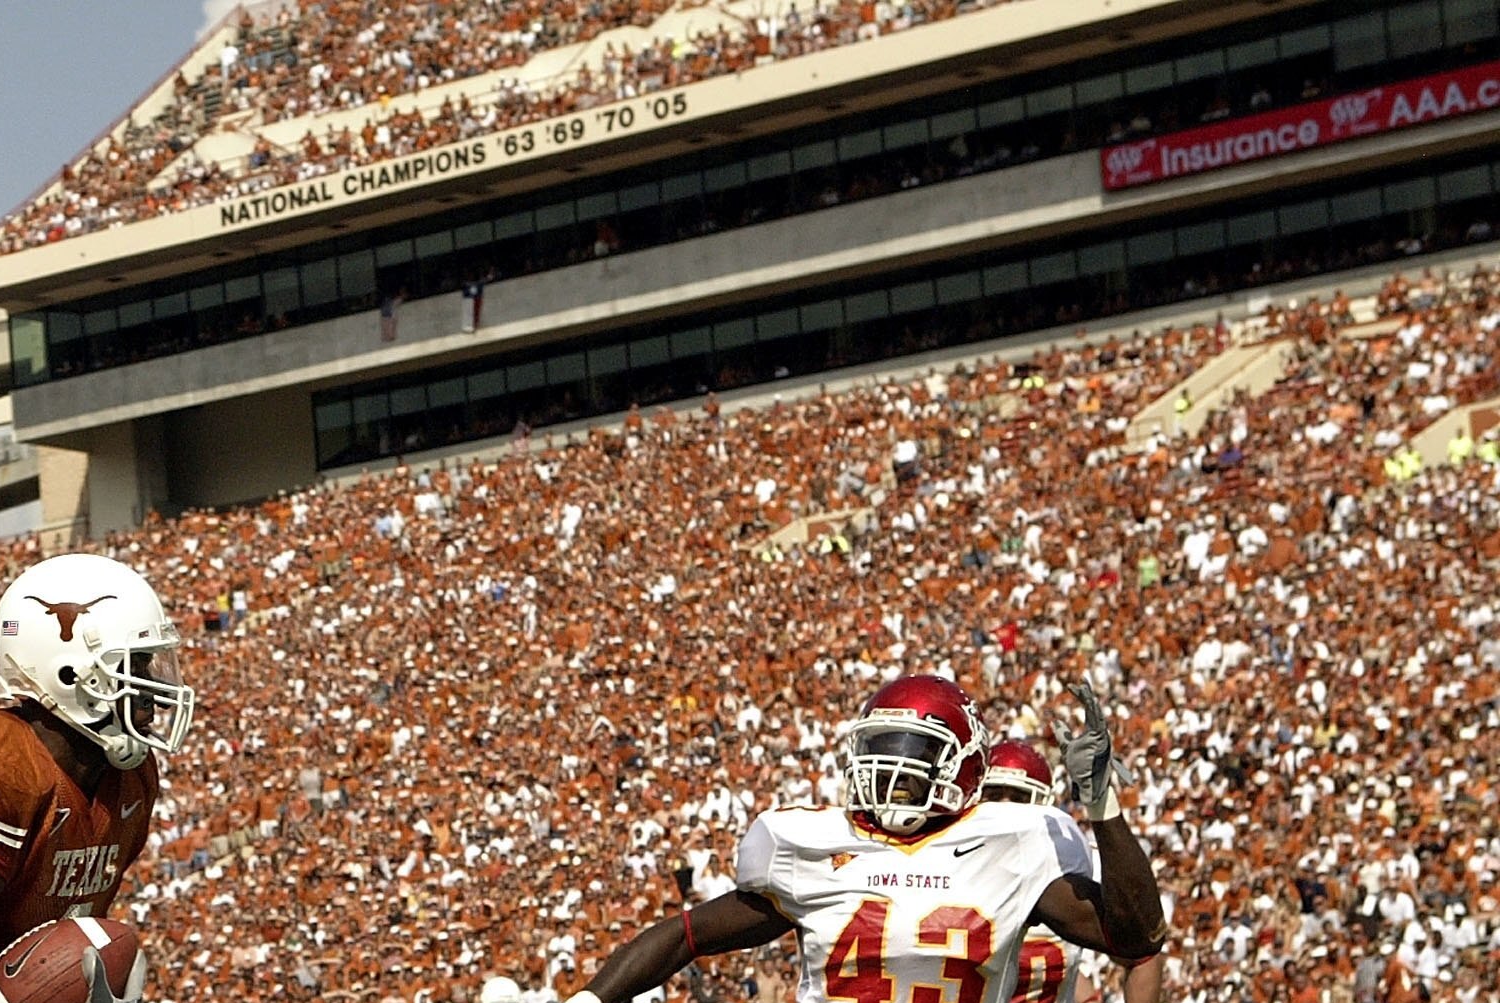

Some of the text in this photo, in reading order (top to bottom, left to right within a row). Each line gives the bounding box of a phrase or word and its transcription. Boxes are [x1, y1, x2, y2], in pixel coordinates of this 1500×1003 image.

[221, 184, 333, 227] NATIONAL
[343, 143, 486, 196] CHAMPIONS
[496, 131, 535, 156] '63
[596, 107, 635, 133] '70
[645, 93, 687, 120] '05
[1161, 119, 1319, 176] Insurance
[45, 845, 119, 897] TEXAS
[867, 873, 950, 889] IOWA STATE
